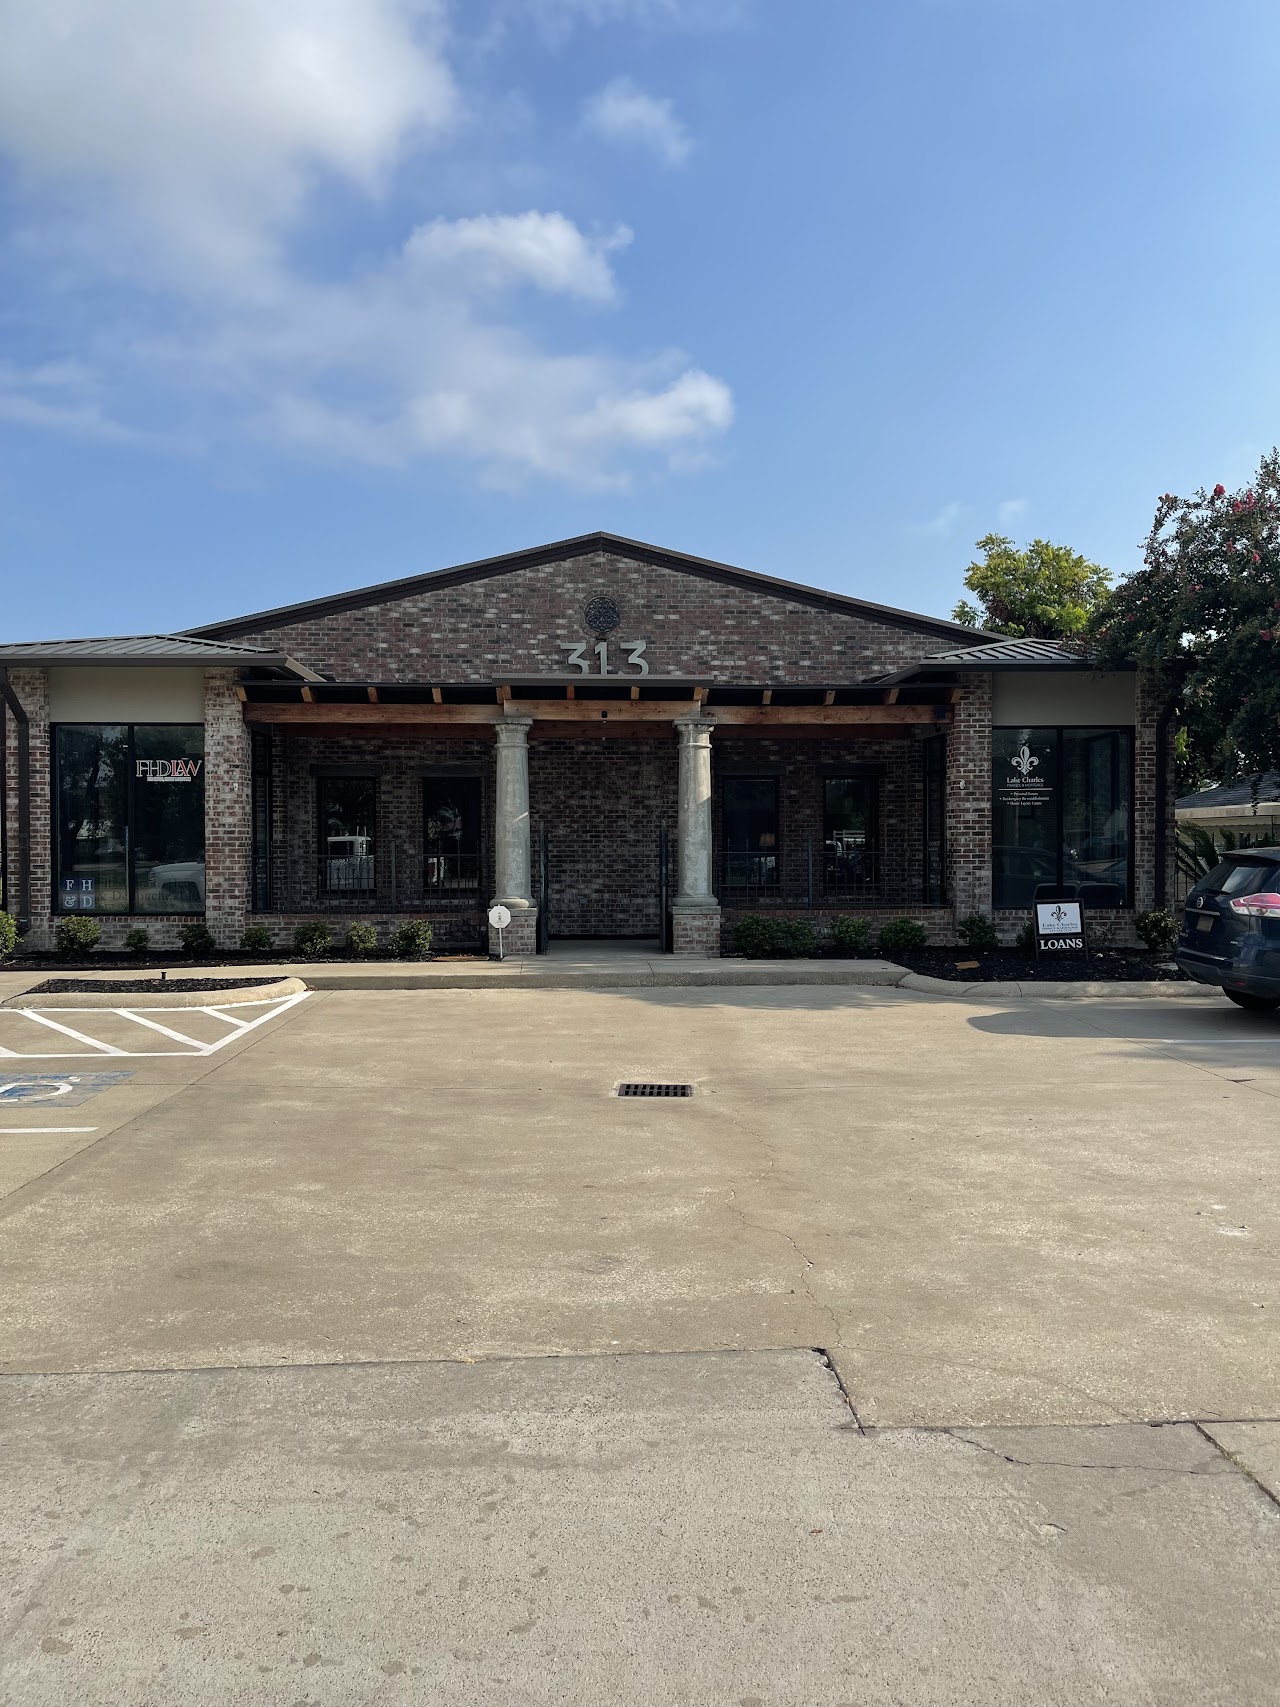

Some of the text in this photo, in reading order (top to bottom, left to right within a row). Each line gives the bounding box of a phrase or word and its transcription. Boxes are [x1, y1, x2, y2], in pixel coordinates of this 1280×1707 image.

[560, 641, 649, 675] 313
[65, 879, 93, 891] F H
[64, 896, 93, 908] & D
[1039, 938, 1083, 950] LOANS
